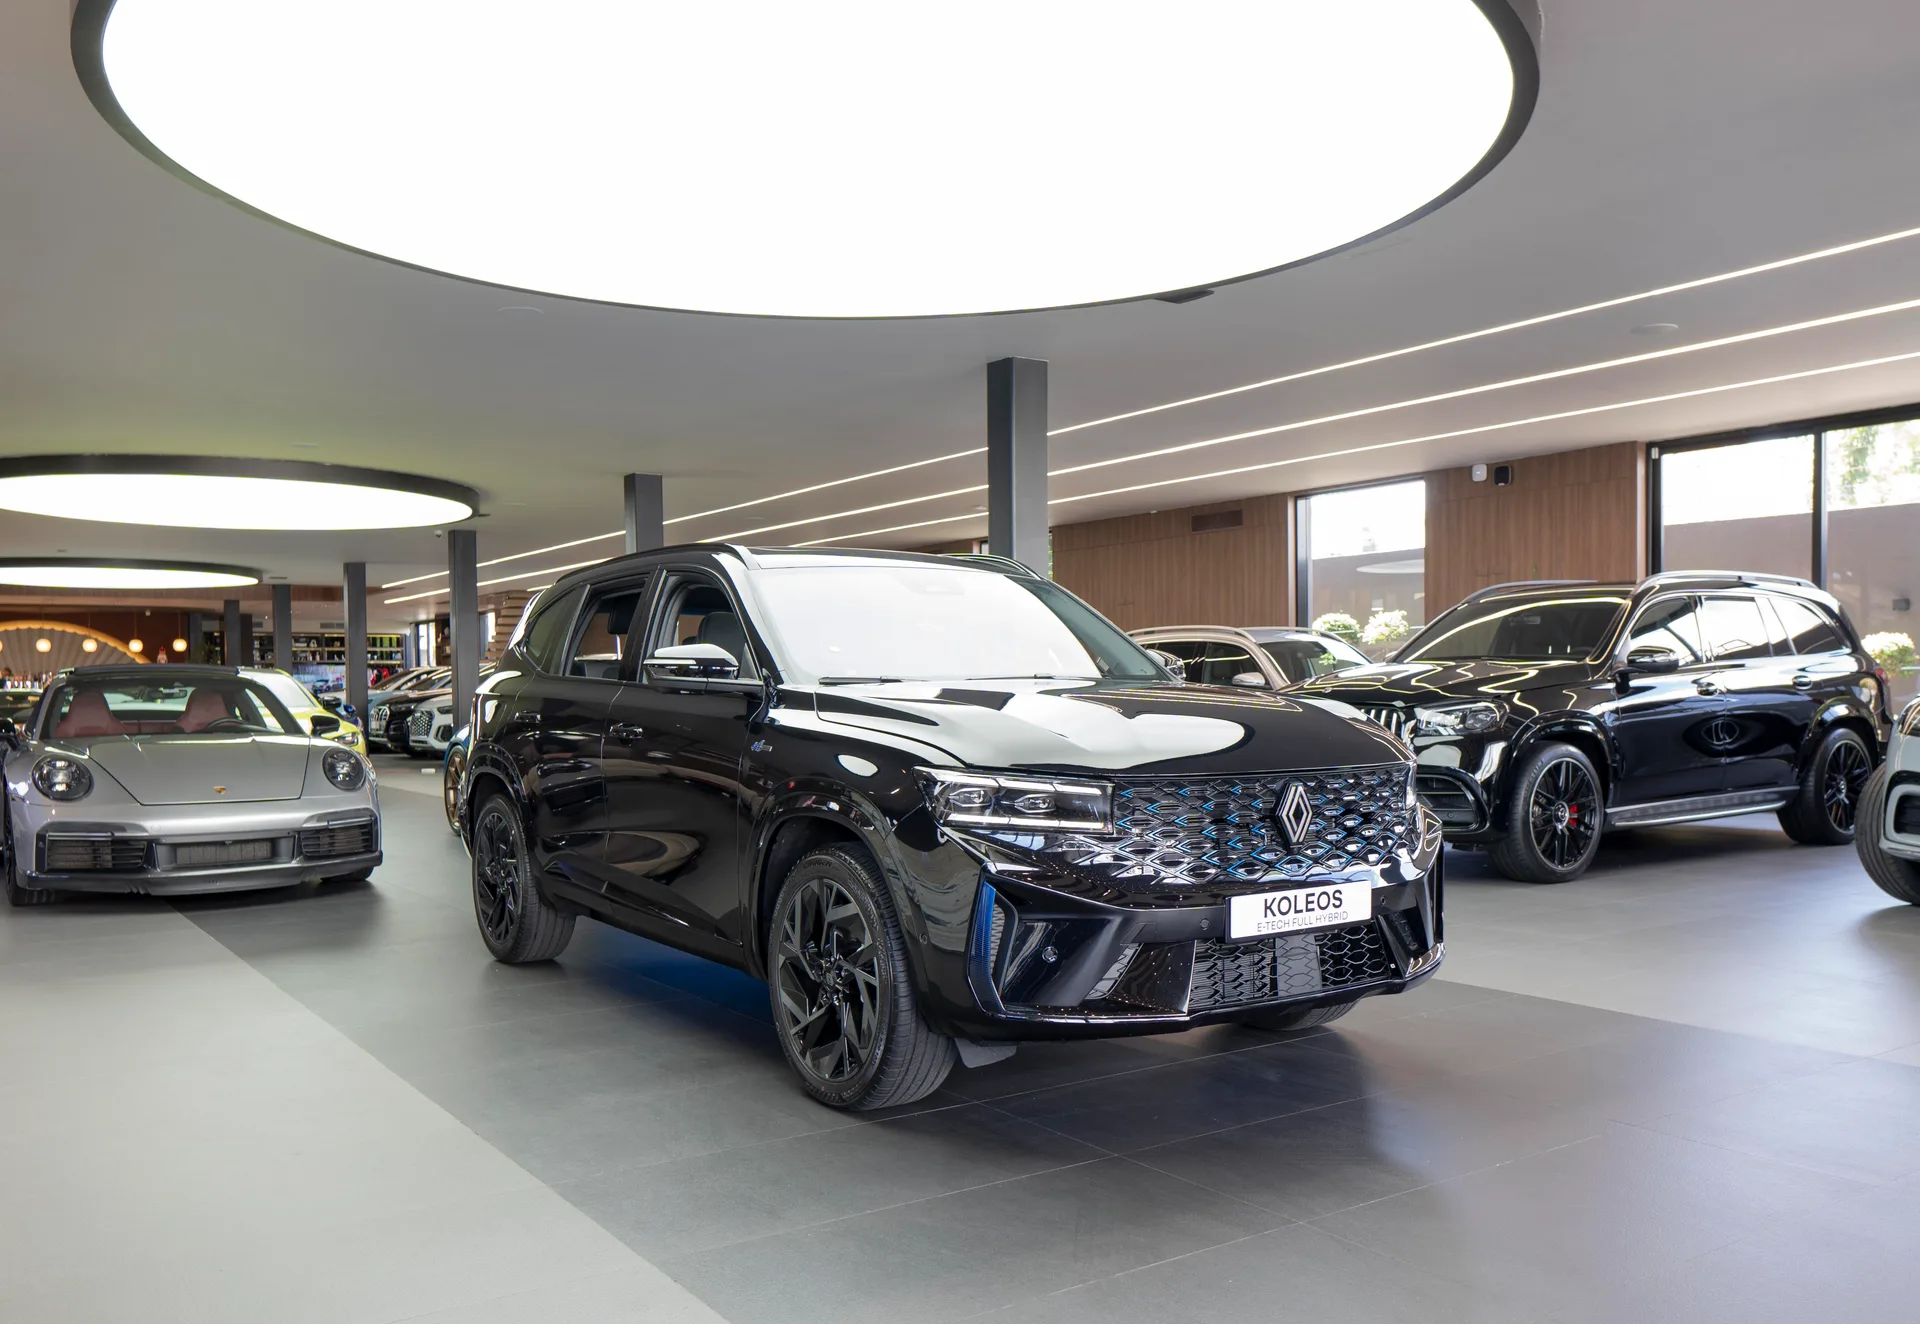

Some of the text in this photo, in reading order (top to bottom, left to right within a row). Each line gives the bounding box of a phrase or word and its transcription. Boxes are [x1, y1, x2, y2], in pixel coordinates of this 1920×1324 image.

[1264, 889, 1343, 918] KOLEOS
[1257, 911, 1349, 932] E-TECH FULL HYBRID
